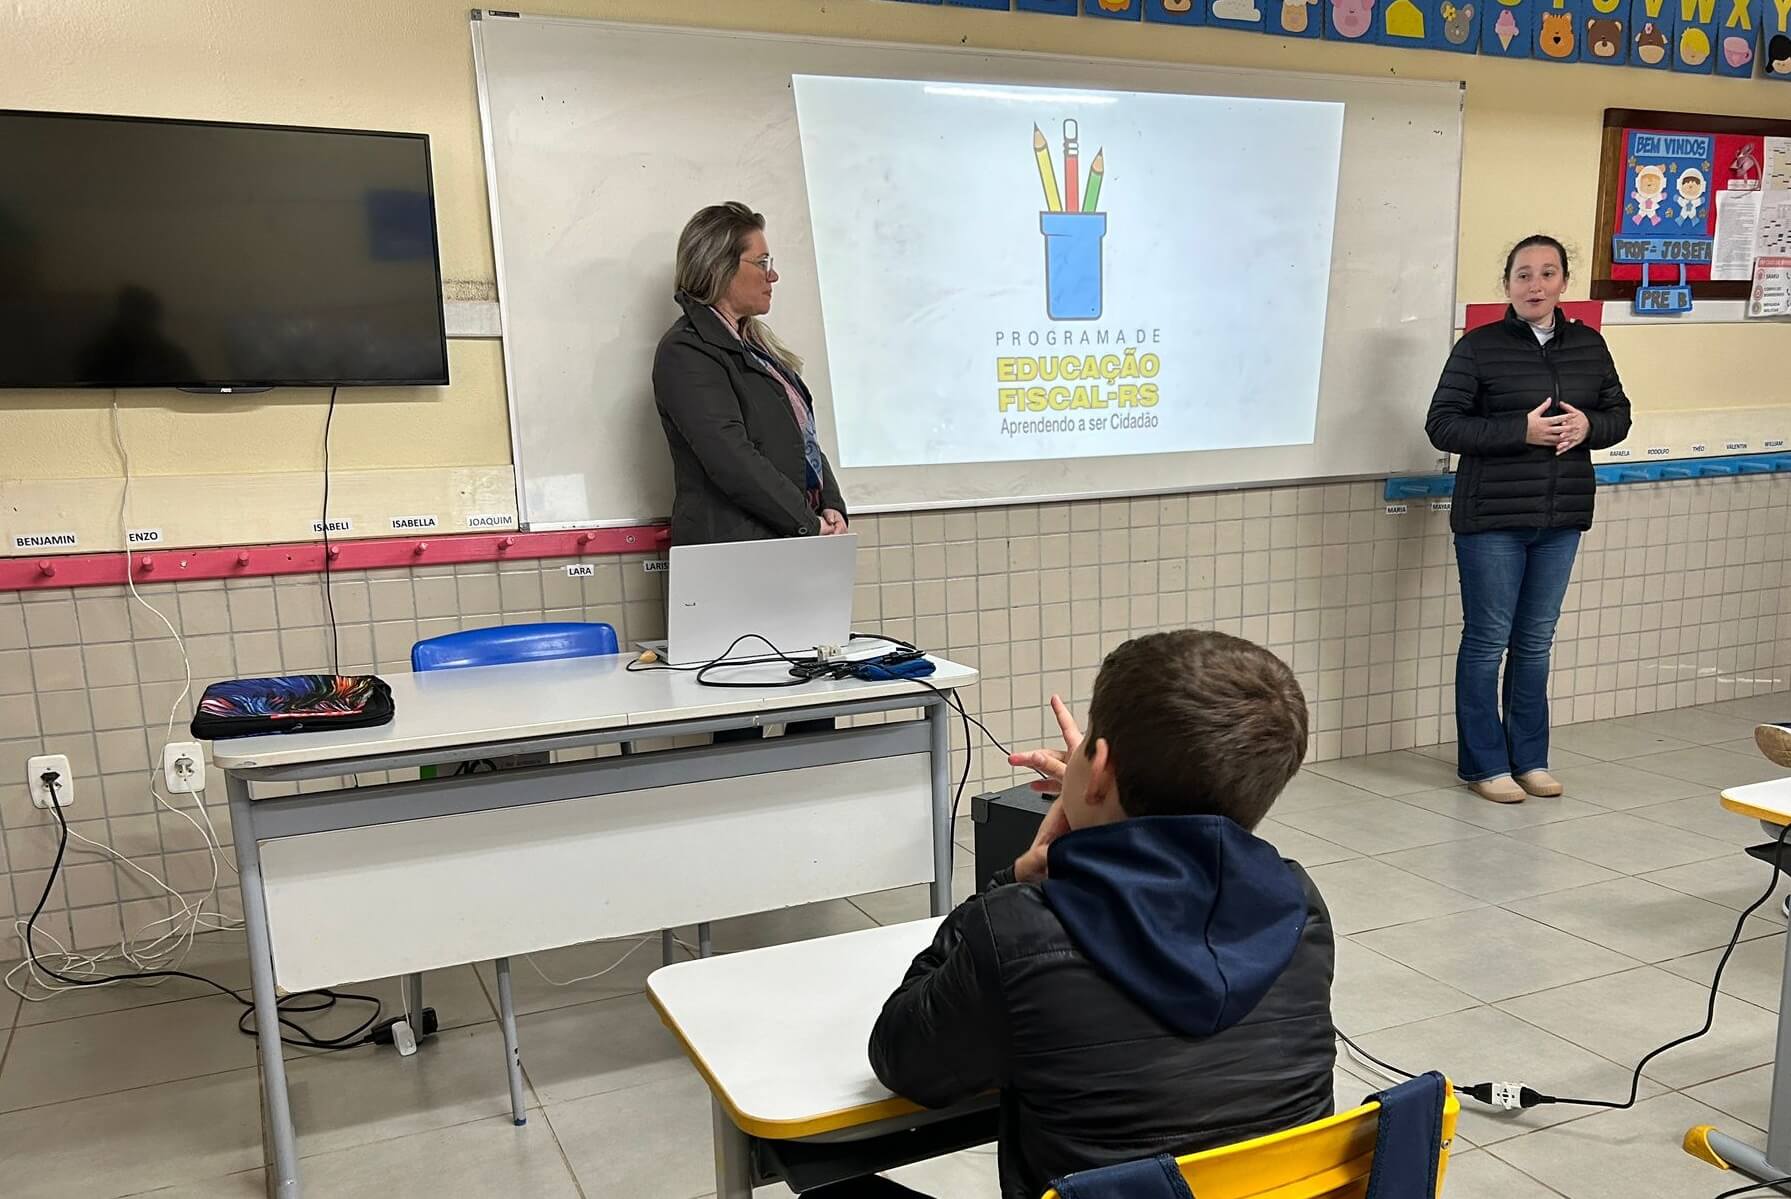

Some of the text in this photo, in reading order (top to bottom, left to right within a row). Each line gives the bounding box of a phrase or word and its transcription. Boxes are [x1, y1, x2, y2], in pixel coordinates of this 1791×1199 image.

[1679, 0, 1715, 24] W
[1725, 0, 1752, 30] X
[1773, 0, 1791, 32] Y
[1636, 136, 1706, 157] BEM VINDOS
[1641, 291, 1688, 309] PRE B
[996, 328, 1160, 346] PROGRAMA DE
[996, 347, 1160, 385] EDUCAÇÃO
[998, 383, 1160, 413] FISCAL-RS
[1000, 412, 1159, 438] Aprendendo a ser Cidadão
[313, 522, 350, 532] ISABELI
[392, 518, 436, 528] ISABELLA
[469, 516, 513, 527] JOAQUIM
[16, 535, 76, 547] BENJAMIN
[128, 532, 159, 542] ENZO
[569, 567, 592, 576] LARA
